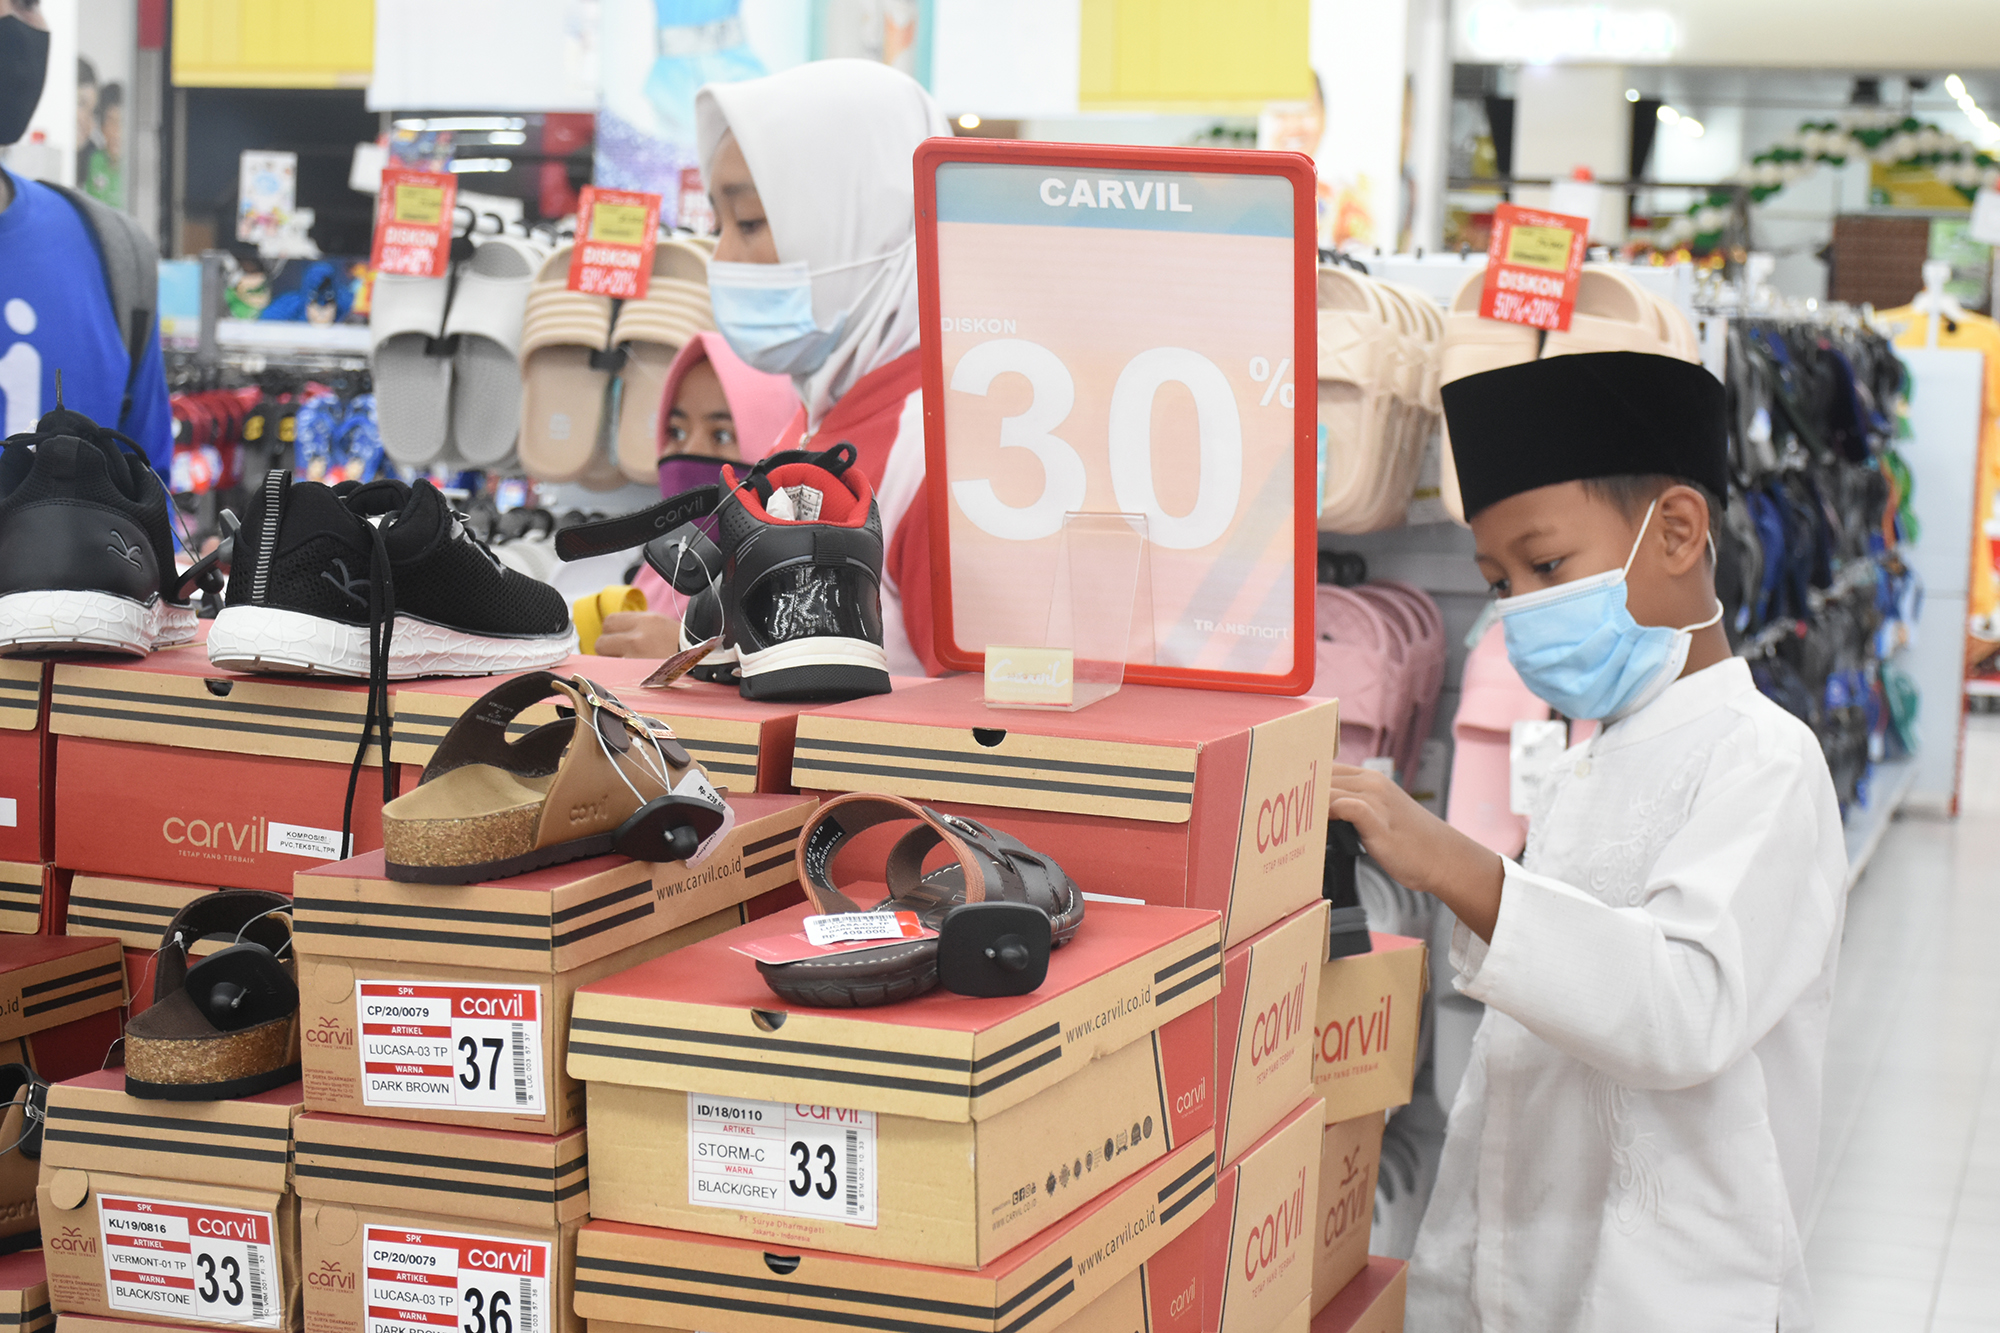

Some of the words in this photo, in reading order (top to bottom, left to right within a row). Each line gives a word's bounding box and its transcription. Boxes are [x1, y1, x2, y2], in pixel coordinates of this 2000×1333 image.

[1039, 178, 1193, 212] CARVIL
[582, 246, 641, 268] DISKON
[1497, 269, 1564, 298] DISKON
[940, 317, 1016, 334] DISKON
[654, 496, 703, 529] carvil
[1257, 760, 1317, 854] carvil
[162, 816, 265, 853] carvil
[178, 850, 200, 858] TETAP
[224, 855, 255, 864] TERBAIK
[656, 856, 741, 901] www.carvil.co.id
[398, 987, 414, 996] SPK
[367, 1005, 429, 1018] CP/20/0079
[460, 994, 523, 1017] carvil
[1065, 984, 1151, 1044] www.carvil.co.id
[1251, 962, 1307, 1067] carvil
[306, 1028, 353, 1046] carvil
[391, 1026, 423, 1035] ARTIKEL
[369, 1044, 430, 1057] LUCASA-03
[433, 1047, 448, 1057] TP
[395, 1065, 424, 1074] WARNA
[458, 1035, 504, 1091] 37
[372, 1080, 403, 1092] DARK
[406, 1082, 450, 1094] BROWN
[1176, 1076, 1206, 1114] carvil
[698, 1104, 763, 1122] ID/18/0110
[723, 1125, 756, 1136] ARTIKEL
[698, 1142, 765, 1162] STORM-C
[725, 1166, 754, 1175] WARNA
[789, 1141, 838, 1201] 33
[698, 1180, 778, 1199] BLACK/GREY
[137, 1204, 152, 1212] SPK
[1324, 1163, 1370, 1247] carvil
[108, 1218, 167, 1234] KL/19/0816
[197, 1217, 257, 1240] carvil
[752, 1216, 775, 1228] Surya
[777, 1220, 825, 1235] Dharmagati
[1245, 1166, 1306, 1282] carvil
[50, 1236, 97, 1254] carvil
[133, 1239, 164, 1249] ARTIKEL
[406, 1234, 422, 1243] SPK
[1077, 1204, 1156, 1277] www.carvil.co.id
[112, 1253, 173, 1269] VERMONT-01
[174, 1261, 187, 1270] TP
[373, 1250, 436, 1267] CP/20/0079
[468, 1249, 532, 1273] carvil
[139, 1274, 165, 1285] WARNA
[196, 1252, 244, 1307] 33
[308, 1272, 355, 1289] carvil
[396, 1273, 429, 1284] ARTIKEL
[116, 1287, 191, 1305] BLACK/STONE
[374, 1288, 436, 1306] LUCASA-03
[438, 1295, 453, 1307] TP
[1170, 1276, 1196, 1317] carvil
[399, 1311, 428, 1322] WARNA
[464, 1287, 512, 1333] 36
